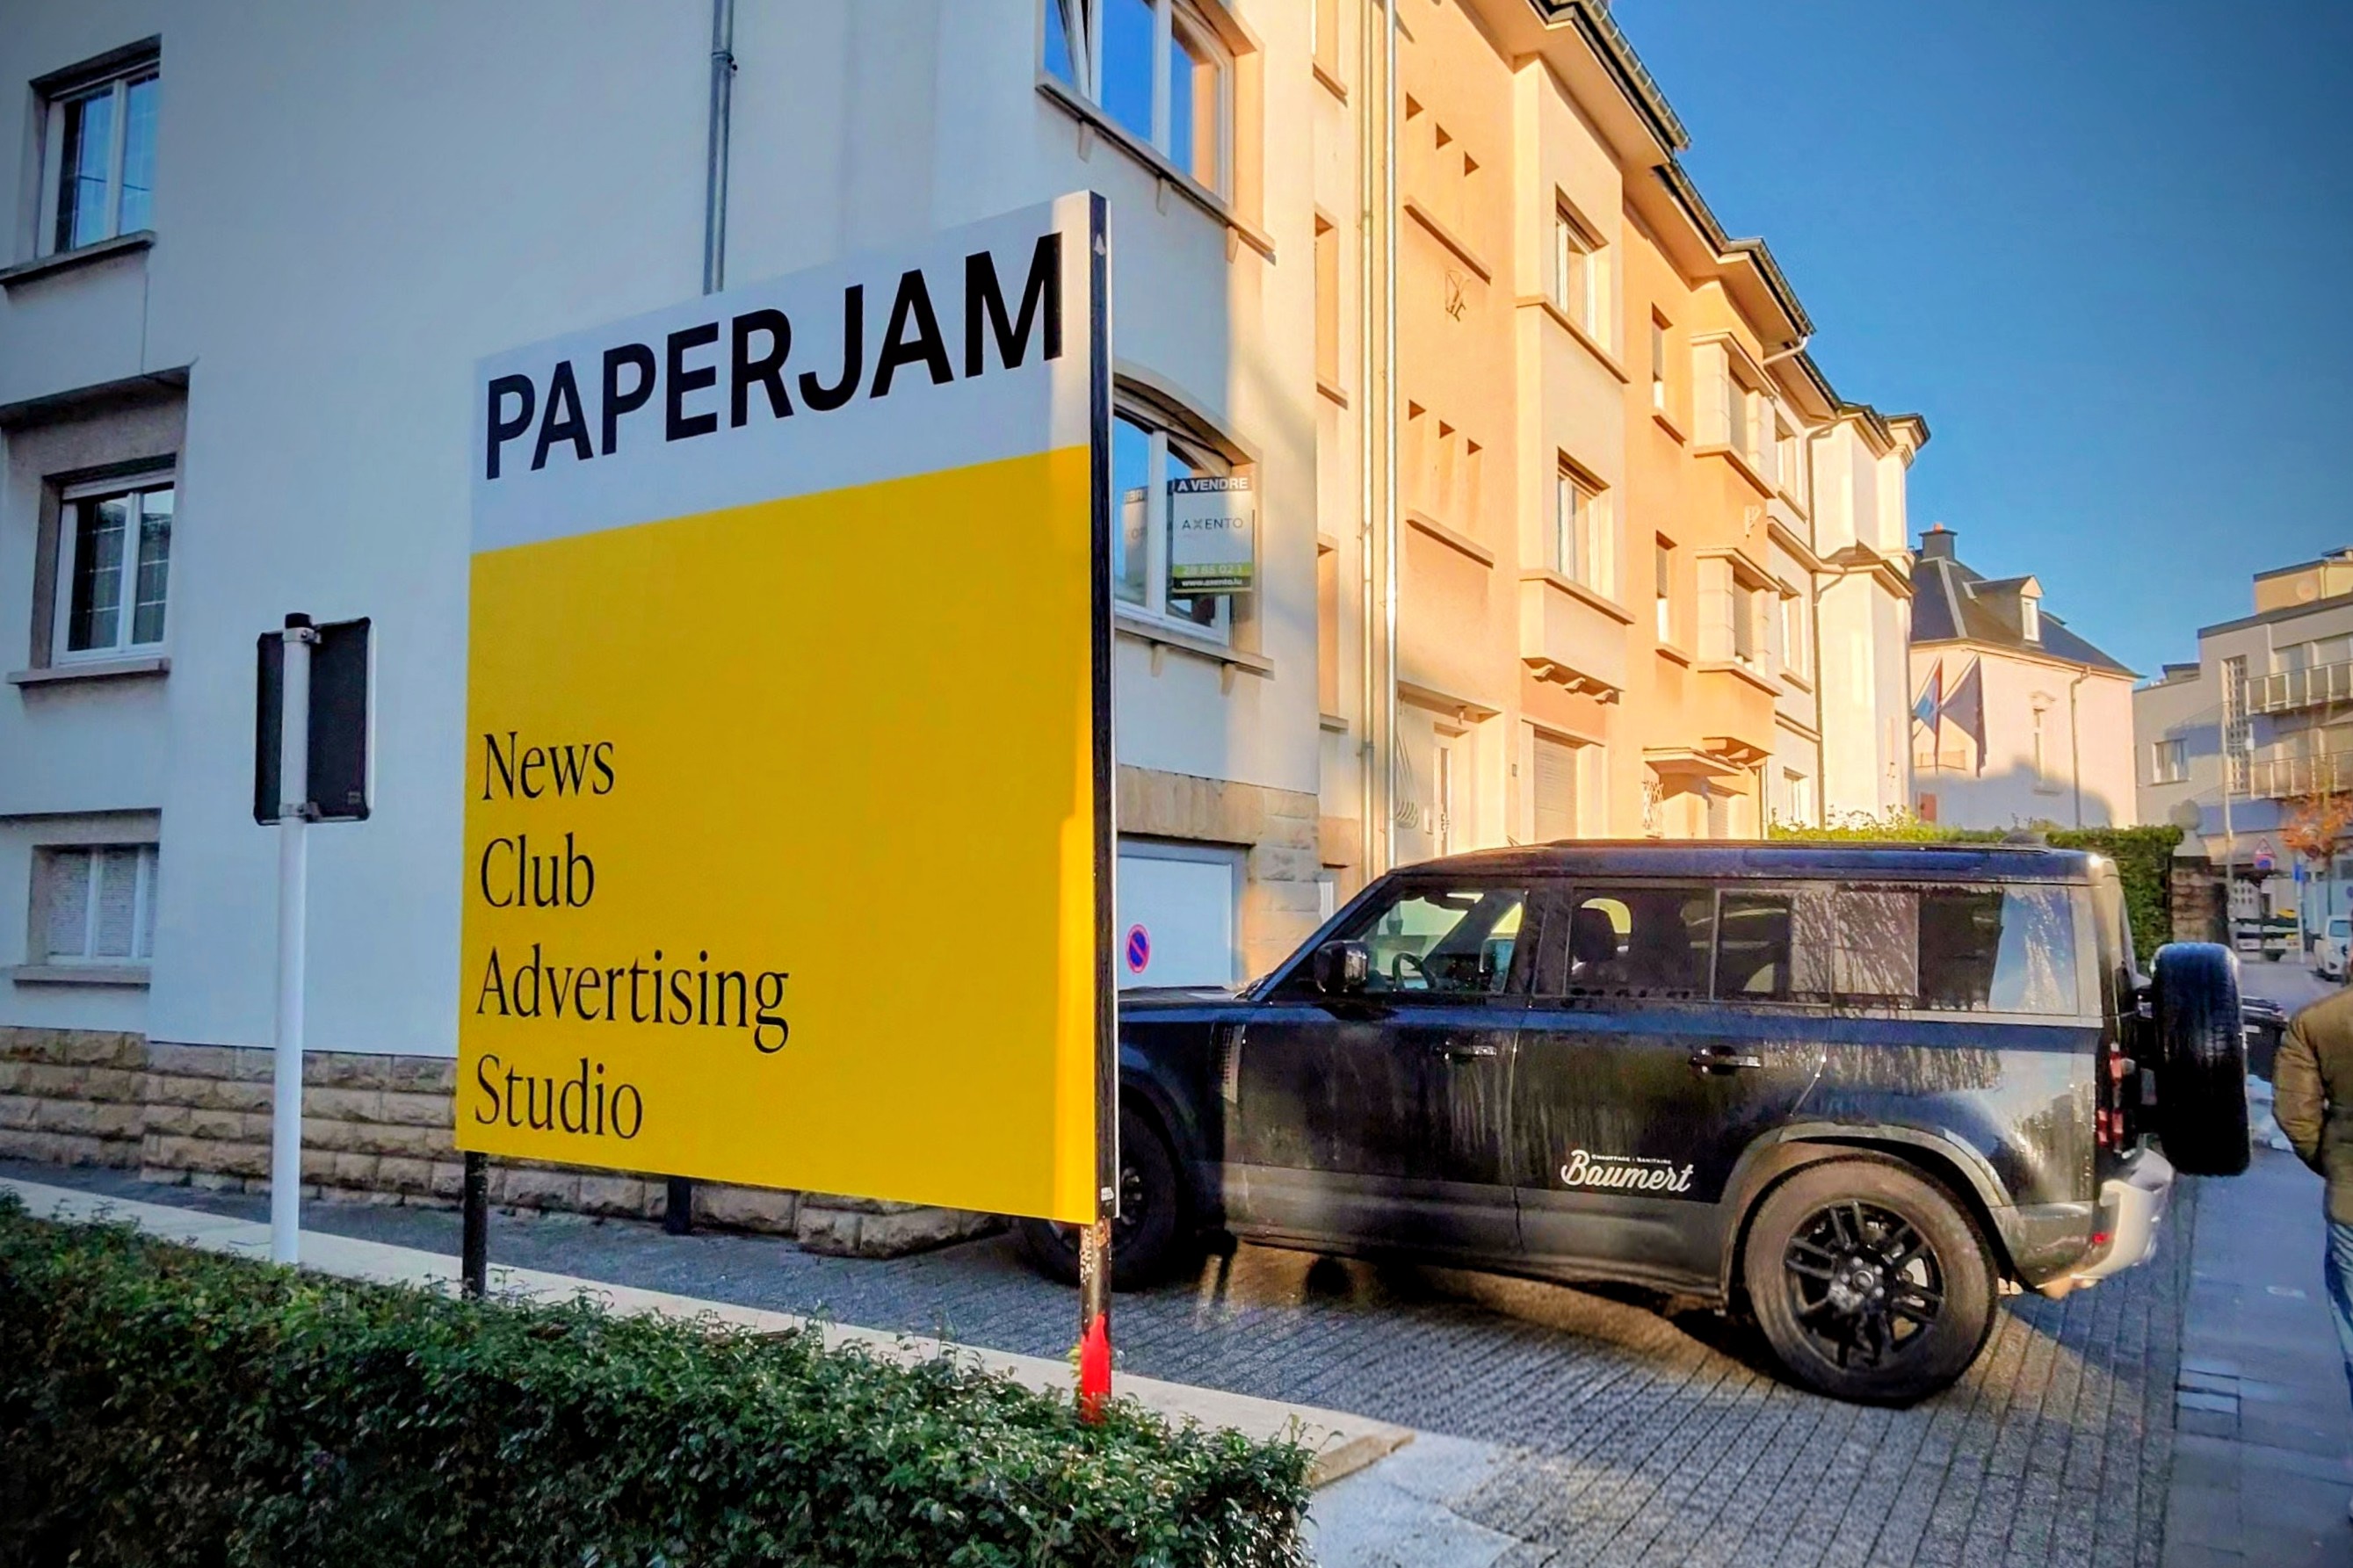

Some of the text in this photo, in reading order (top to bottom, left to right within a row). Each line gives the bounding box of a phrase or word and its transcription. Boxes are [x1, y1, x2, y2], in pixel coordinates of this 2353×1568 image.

[486, 231, 1063, 481] PAPERJAM
[1177, 478, 1248, 492] A VENDRE
[1182, 517, 1243, 530] AXENTO
[1182, 578, 1242, 587] www.axento.lu
[481, 732, 614, 800] News
[481, 832, 595, 907] Club
[476, 943, 789, 1053] Advertising
[475, 1054, 643, 1139] Studio
[1560, 1149, 1694, 1192] Baumert
